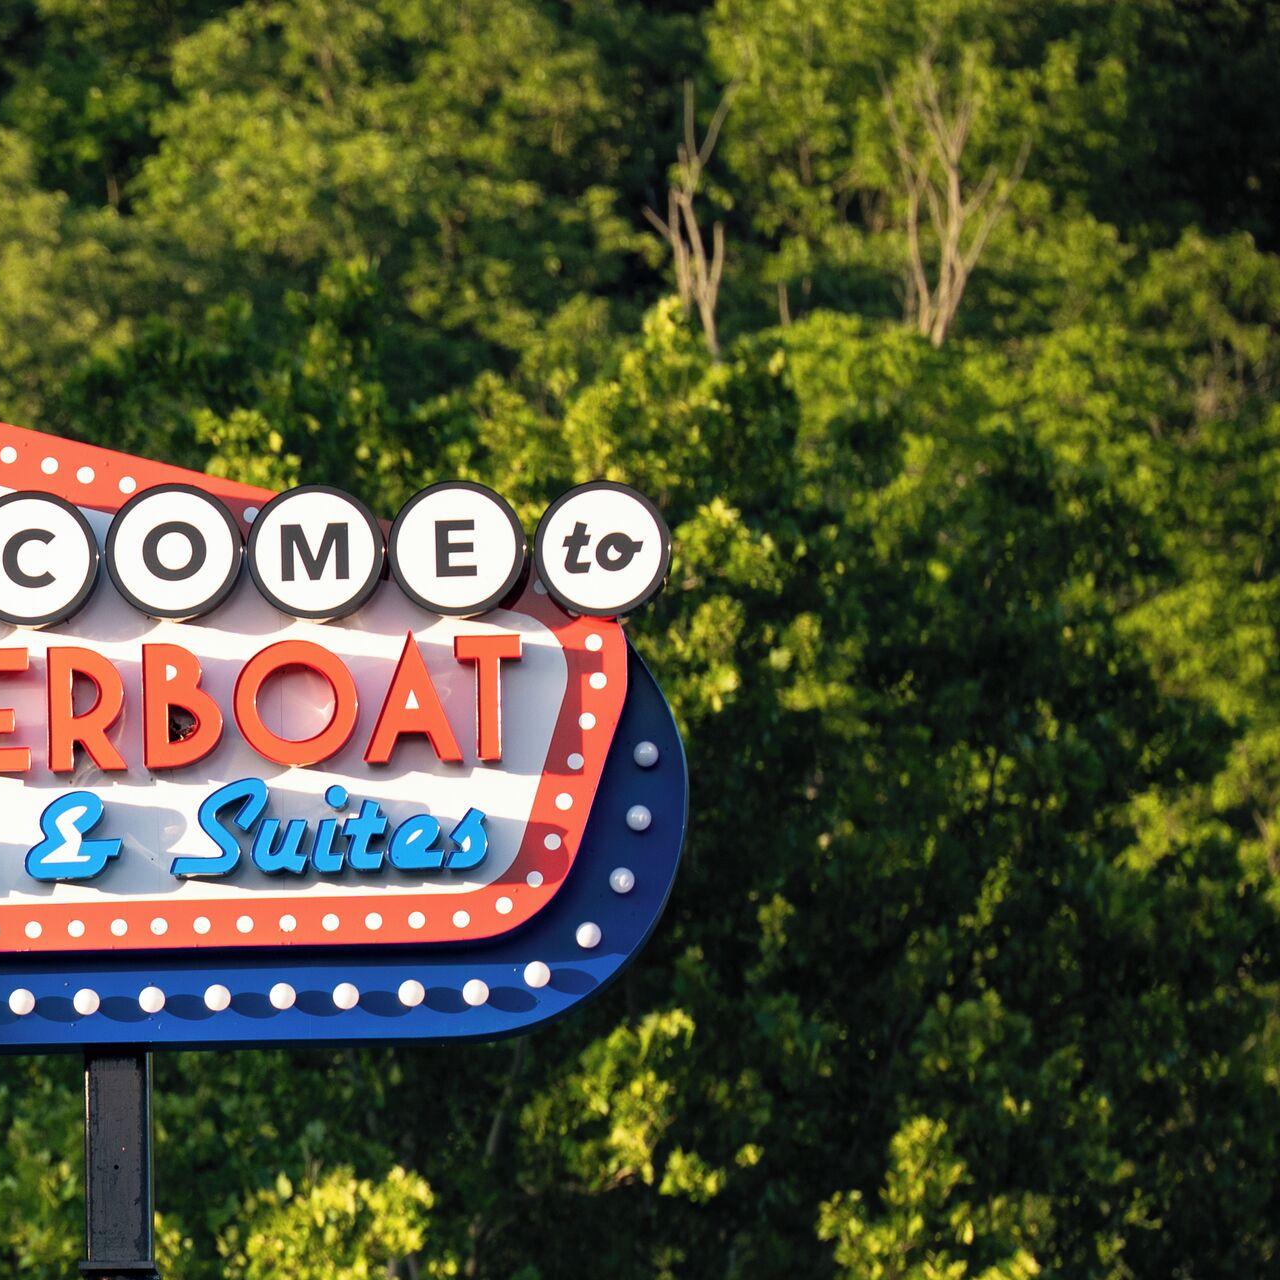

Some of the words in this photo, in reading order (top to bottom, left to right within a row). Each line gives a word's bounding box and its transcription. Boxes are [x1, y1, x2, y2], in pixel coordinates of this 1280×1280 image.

[561, 520, 643, 575] to
[24, 789, 121, 883] &
[169, 777, 490, 879] Suites
